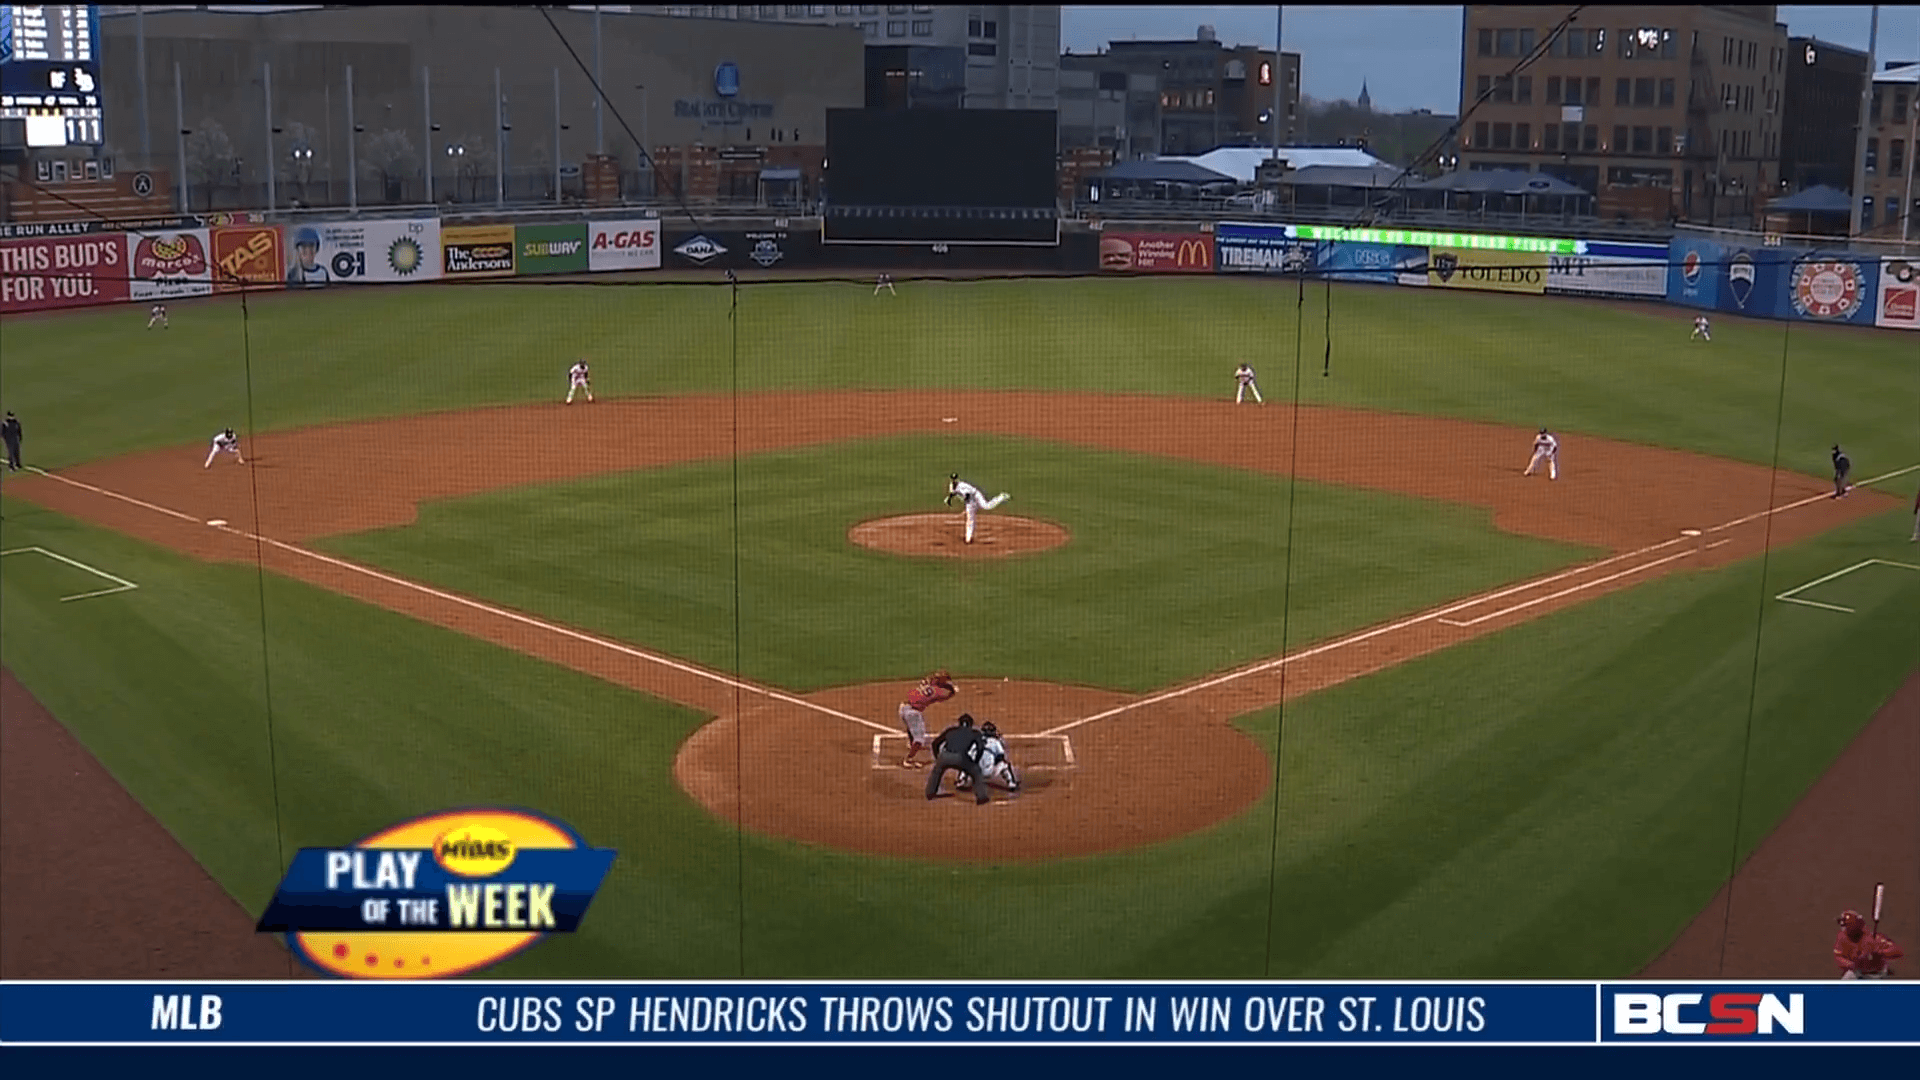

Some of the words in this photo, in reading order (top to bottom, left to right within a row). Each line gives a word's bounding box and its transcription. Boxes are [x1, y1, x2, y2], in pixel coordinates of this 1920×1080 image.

[16, 224, 45, 235] RUN
[49, 222, 91, 234] ALLEY
[408, 222, 424, 235] bp
[3, 245, 49, 272] THIS
[54, 241, 119, 269] BUD'S
[220, 231, 273, 276] TAS
[448, 246, 470, 260] The
[523, 240, 582, 256] SUBWAY
[448, 257, 511, 271] Andersons
[1221, 246, 1283, 268] TIREMAN
[1457, 266, 1541, 284] TOLEDO
[2, 276, 45, 302] FOR
